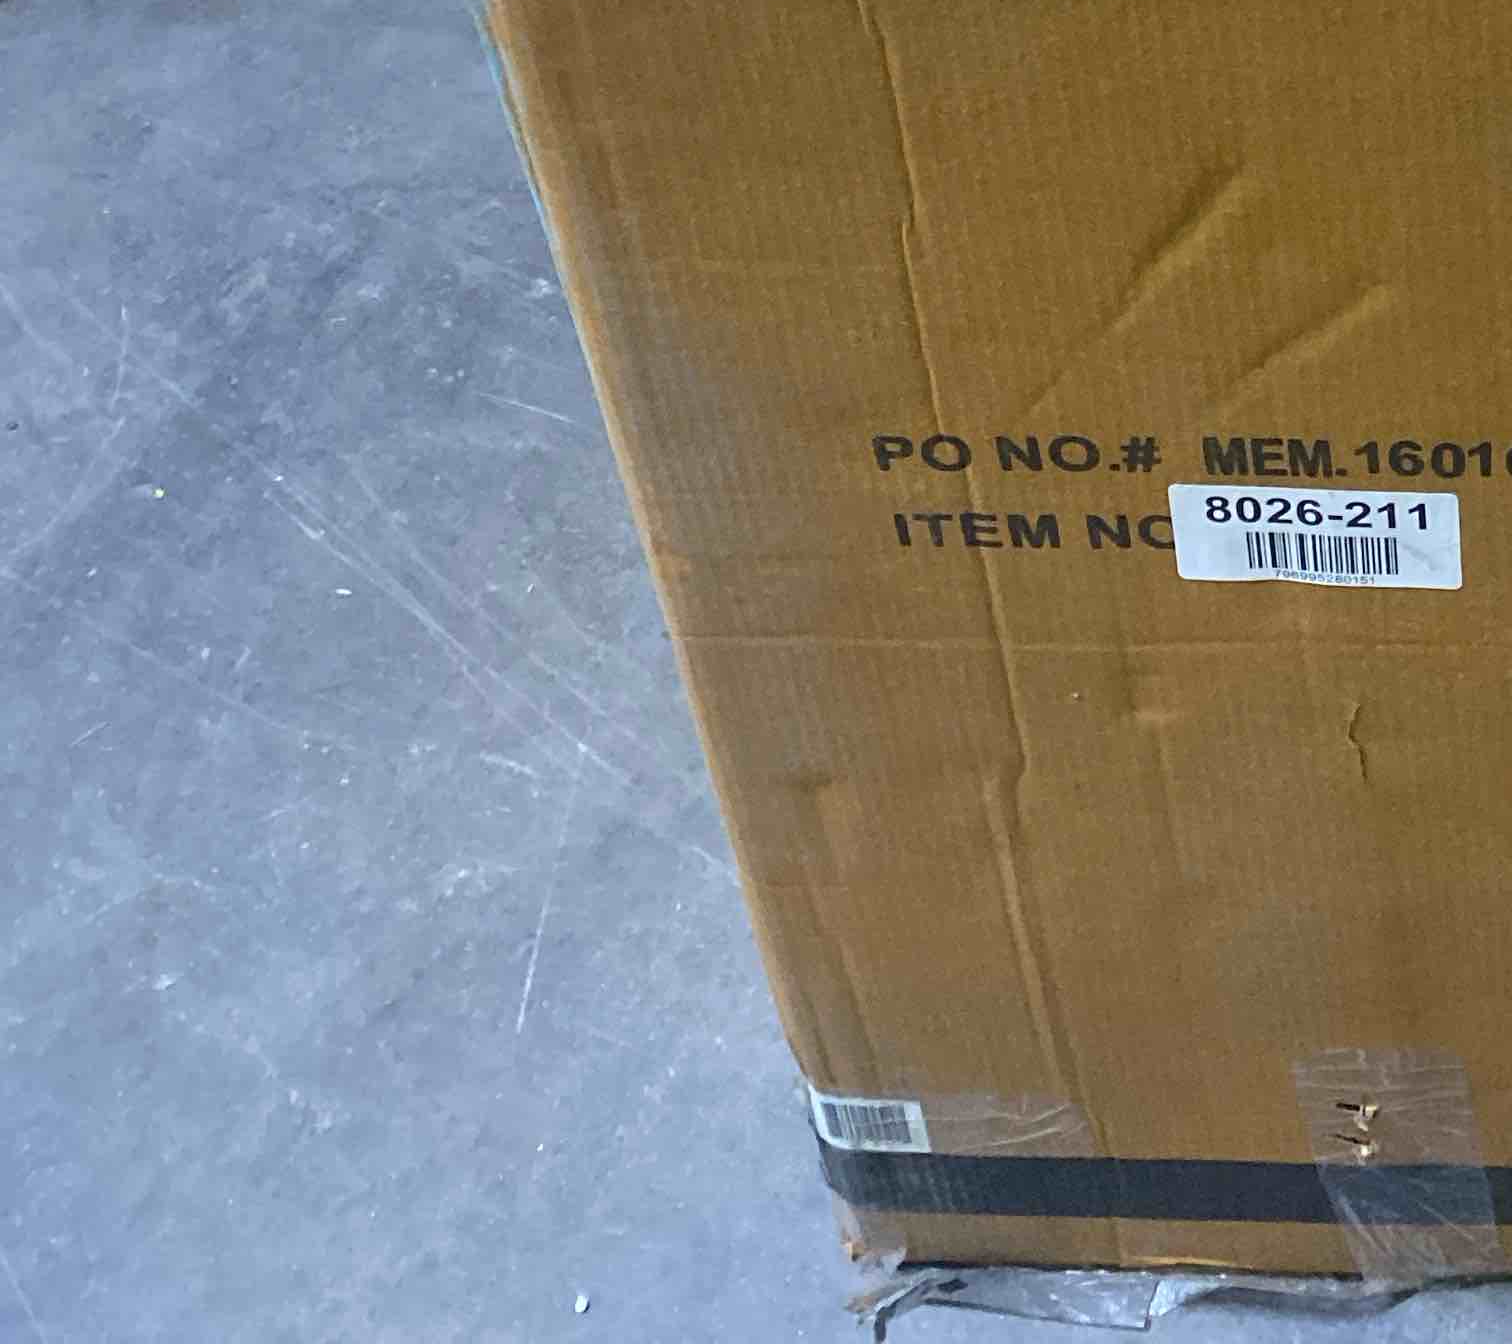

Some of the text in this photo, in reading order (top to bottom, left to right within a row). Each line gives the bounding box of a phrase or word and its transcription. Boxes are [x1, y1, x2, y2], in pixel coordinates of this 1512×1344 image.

[872, 434, 972, 472] PO
[995, 435, 1162, 472] NO.#
[894, 512, 1061, 548] ITEM
[1206, 496, 1428, 530] 8026-211
